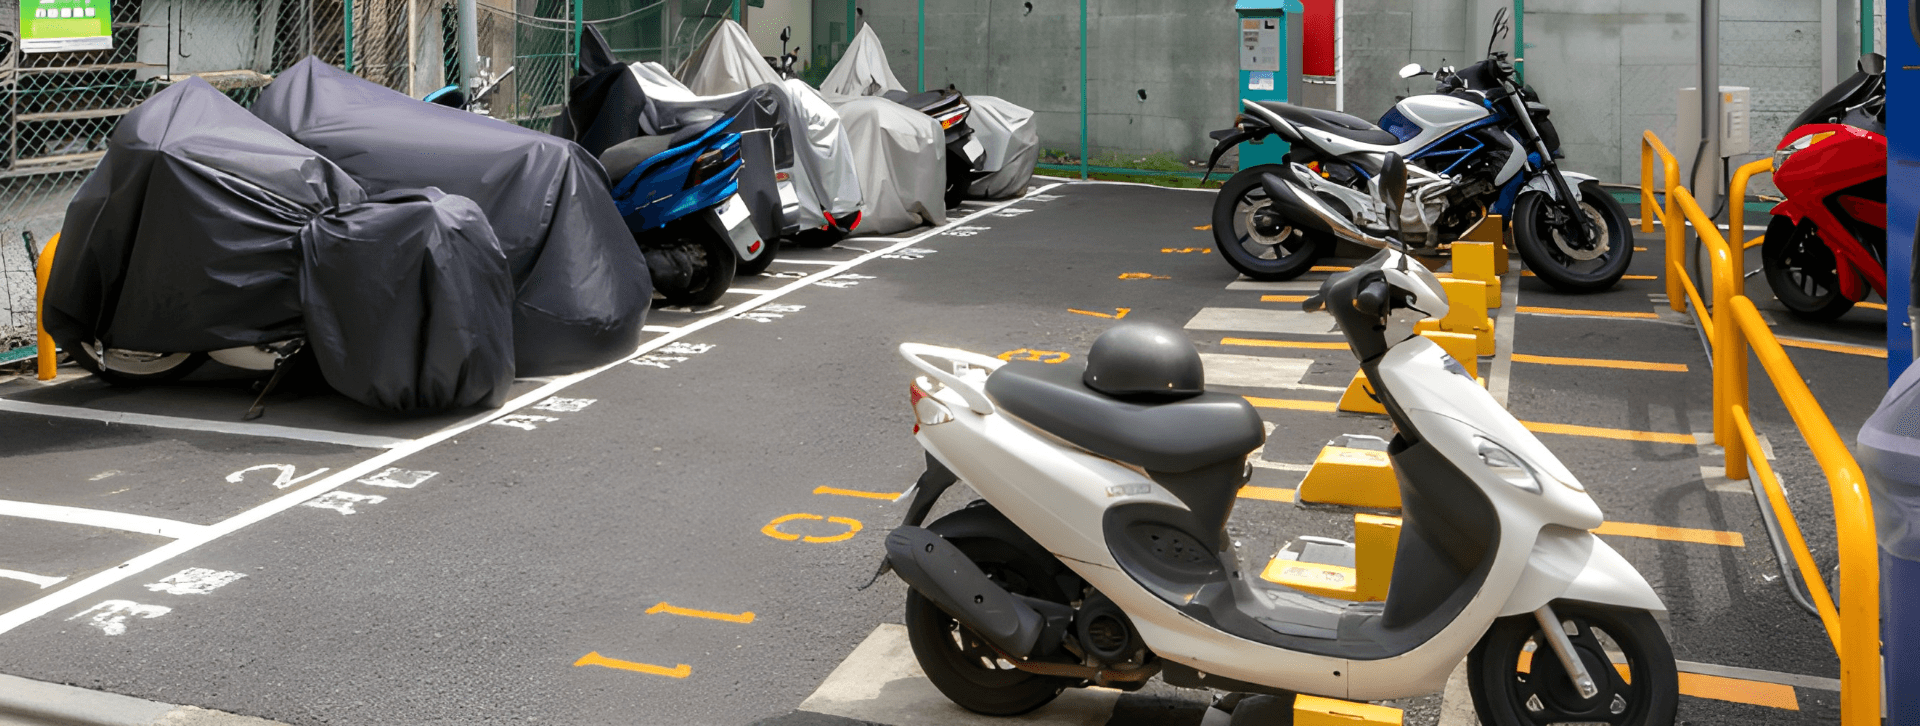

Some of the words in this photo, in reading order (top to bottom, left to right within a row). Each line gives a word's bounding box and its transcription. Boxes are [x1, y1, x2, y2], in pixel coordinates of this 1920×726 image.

[1067, 307, 1131, 319] 7
[225, 464, 330, 489] 2
[760, 485, 901, 543] 10
[573, 601, 755, 678] 11
